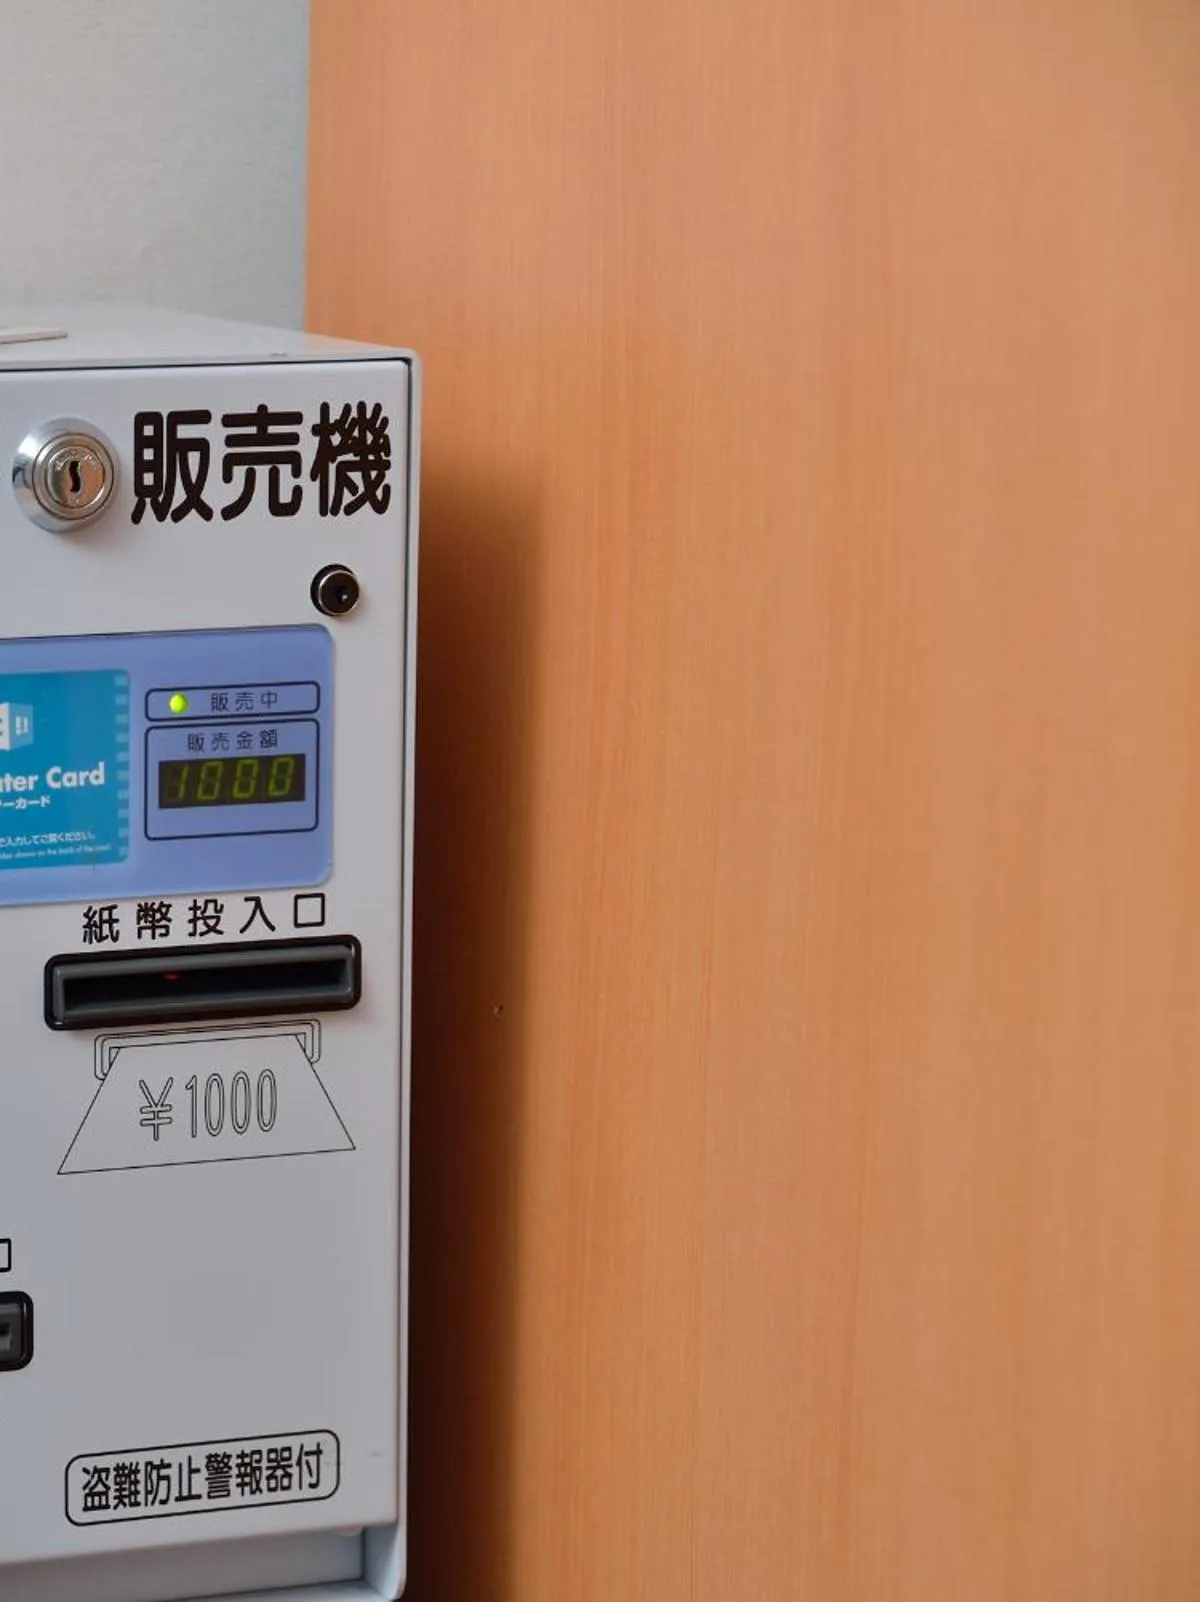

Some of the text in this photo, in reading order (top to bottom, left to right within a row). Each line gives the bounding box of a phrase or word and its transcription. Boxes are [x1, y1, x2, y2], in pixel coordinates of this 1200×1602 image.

[130, 401, 392, 526] 販売機
[210, 690, 278, 713] 販売中
[186, 729, 278, 752] 販売金額
[46, 761, 106, 790] Card
[178, 757, 295, 800] 1000
[81, 892, 326, 946] 紙幣投入口
[138, 1068, 279, 1142] ¥1000
[81, 1442, 324, 1513] 盗難防止警報器付
